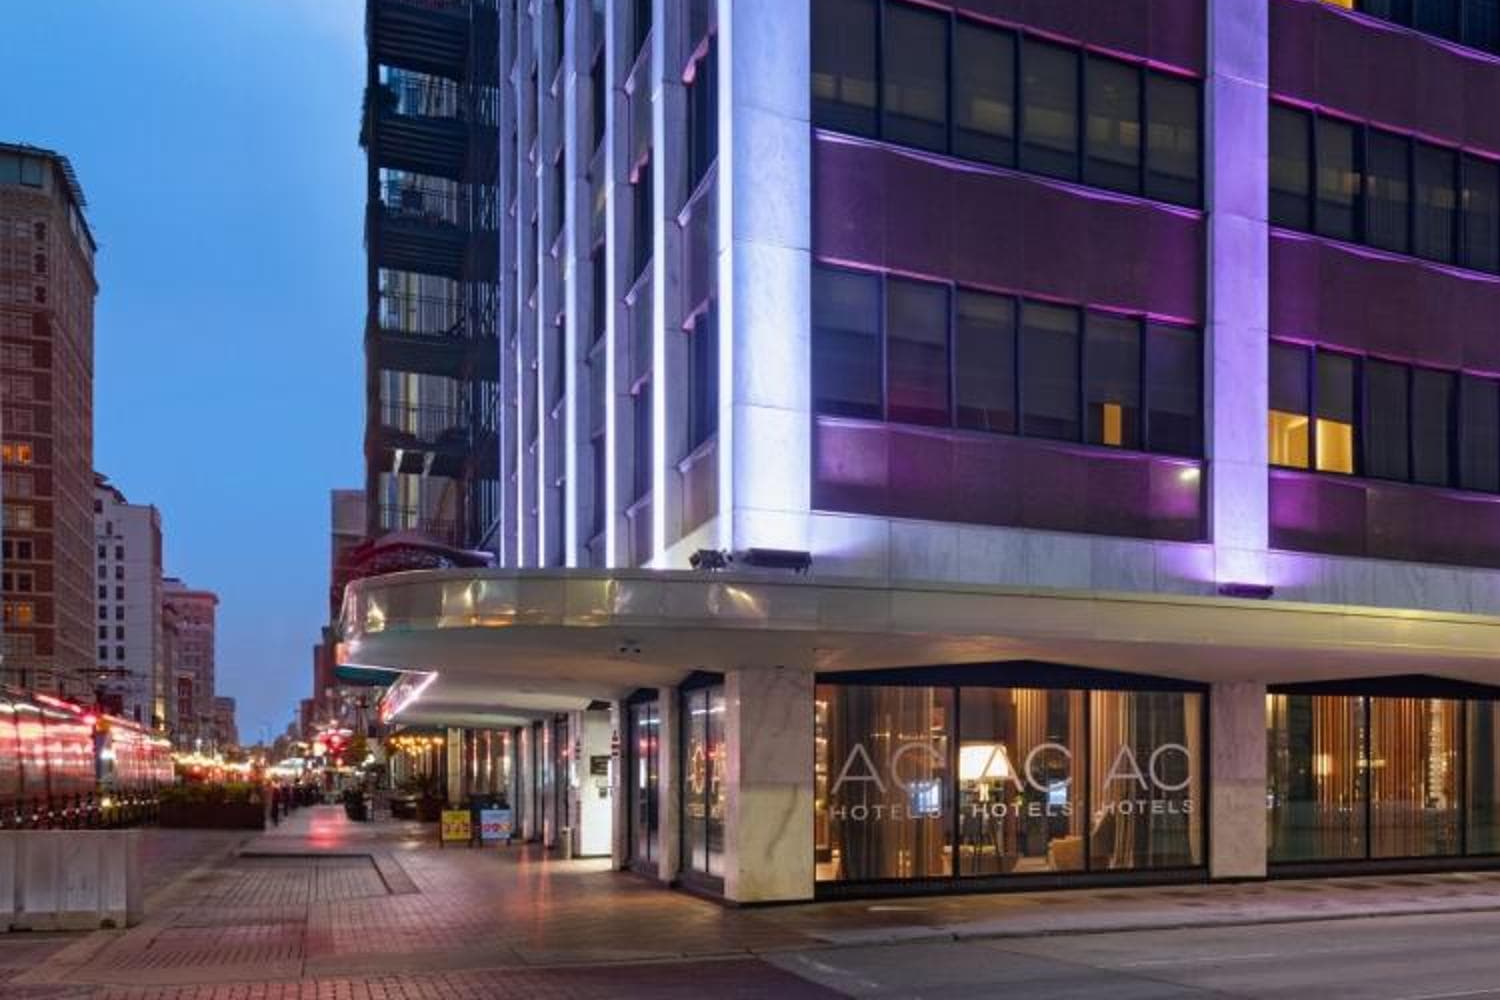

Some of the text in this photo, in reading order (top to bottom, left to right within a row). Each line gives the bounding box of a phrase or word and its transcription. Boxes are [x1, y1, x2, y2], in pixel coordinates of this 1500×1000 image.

[831, 743, 944, 794] AC
[976, 743, 1073, 793] AC
[1103, 743, 1193, 792] AC
[830, 802, 943, 822] HOTELS
[973, 801, 1073, 818] HOTELS
[1101, 798, 1194, 816] HOTELS
